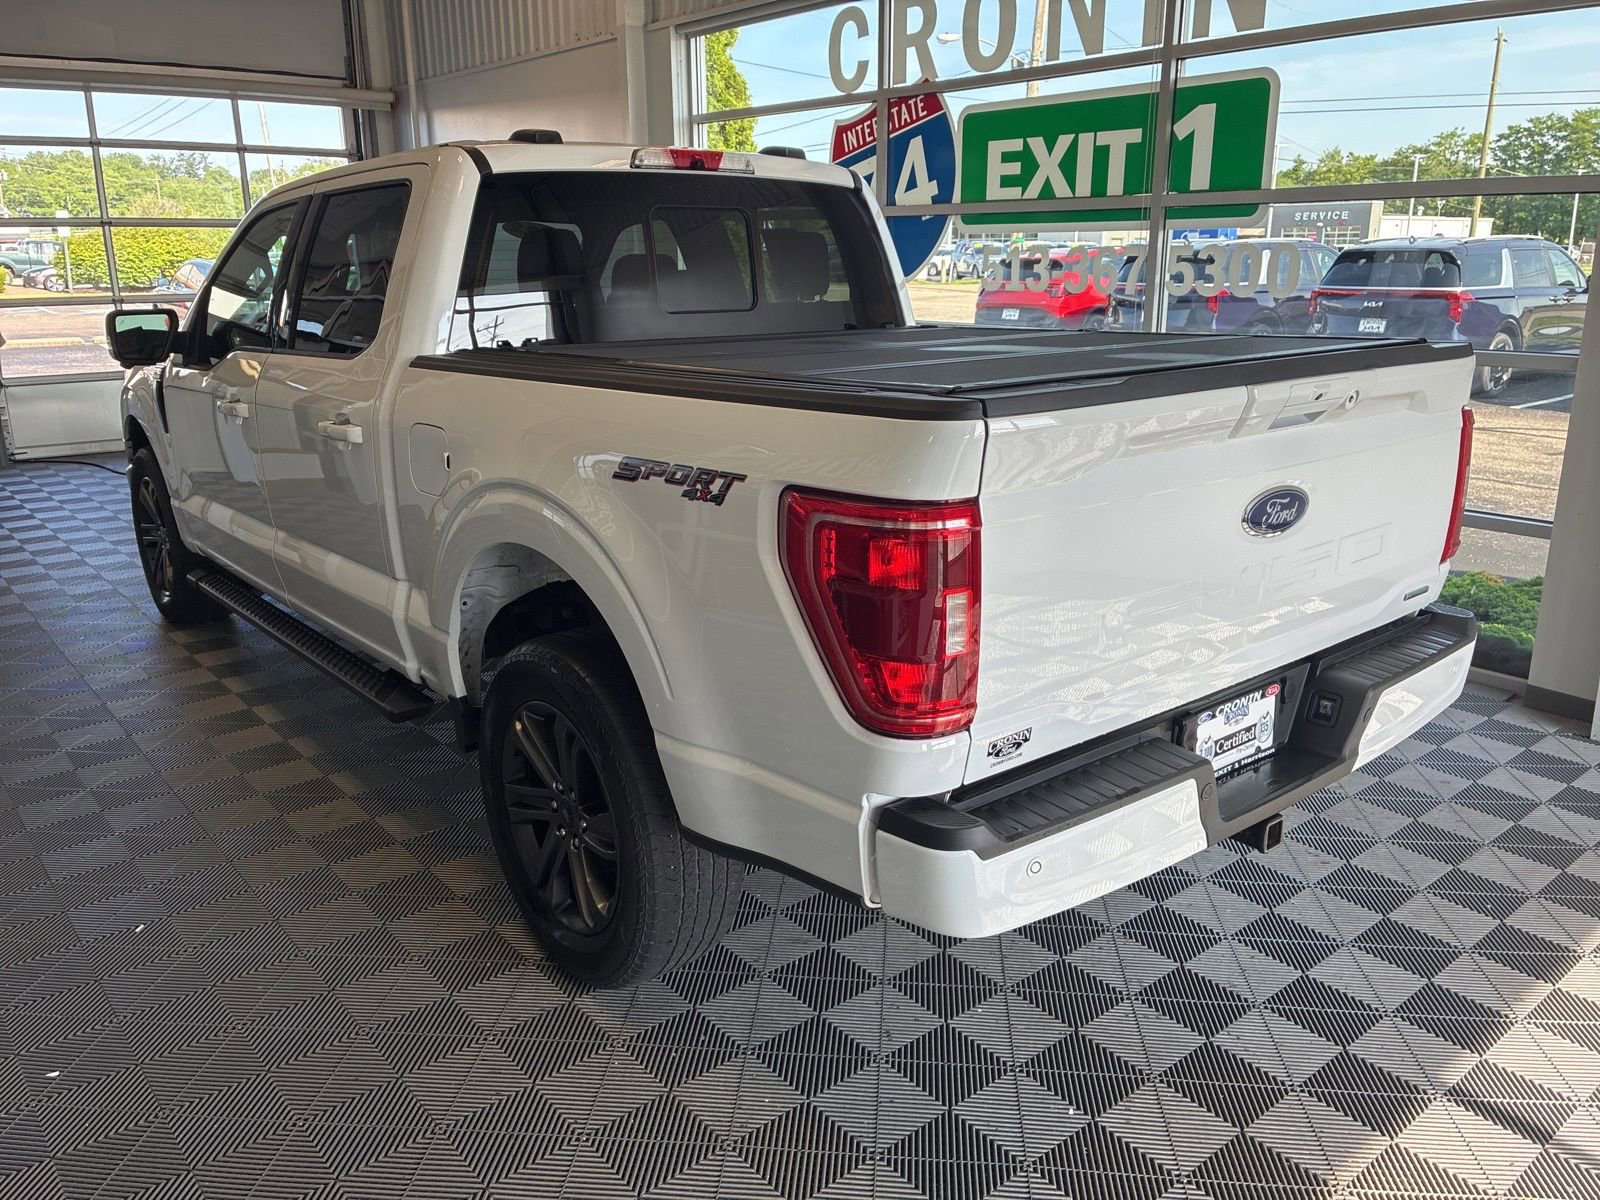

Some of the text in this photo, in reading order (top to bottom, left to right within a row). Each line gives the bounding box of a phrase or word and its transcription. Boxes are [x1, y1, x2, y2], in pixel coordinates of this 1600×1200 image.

[842, 95, 928, 153] INTERTATE
[986, 103, 1217, 201] EXIT 1
[1294, 210, 1349, 221] SERVICE
[981, 243, 1301, 298] 513-3675300
[611, 455, 748, 494] SPORT
[680, 487, 727, 507] 4x4
[1261, 496, 1299, 528] Ford
[1215, 690, 1262, 718] CRONIN
[1224, 706, 1249, 725] CRONIN
[988, 728, 1031, 754] CRONIN
[1216, 726, 1255, 754] Certified
[1240, 748, 1276, 766] Harrison
